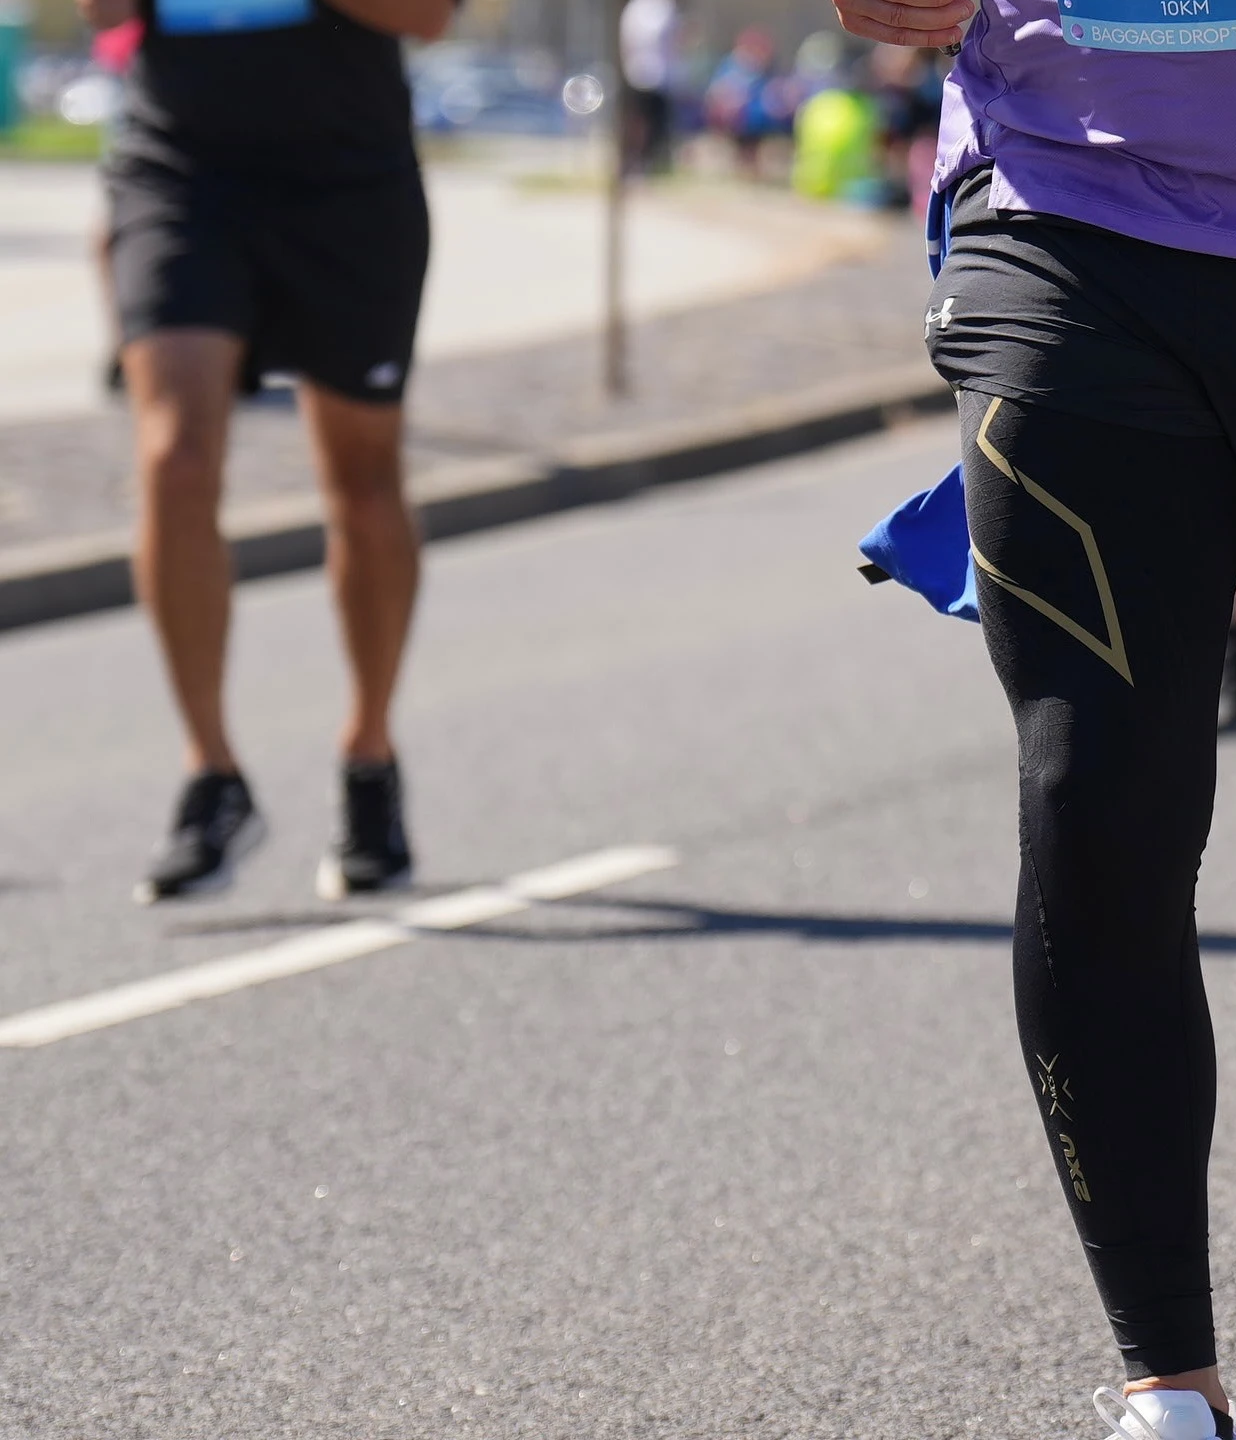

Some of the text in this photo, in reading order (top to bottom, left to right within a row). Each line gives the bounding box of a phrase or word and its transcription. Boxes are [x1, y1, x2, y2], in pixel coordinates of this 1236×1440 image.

[1160, 0, 1210, 16] 10KM
[1091, 25, 1175, 45] BAGGAGE
[1059, 1133, 1092, 1202] 2XU
